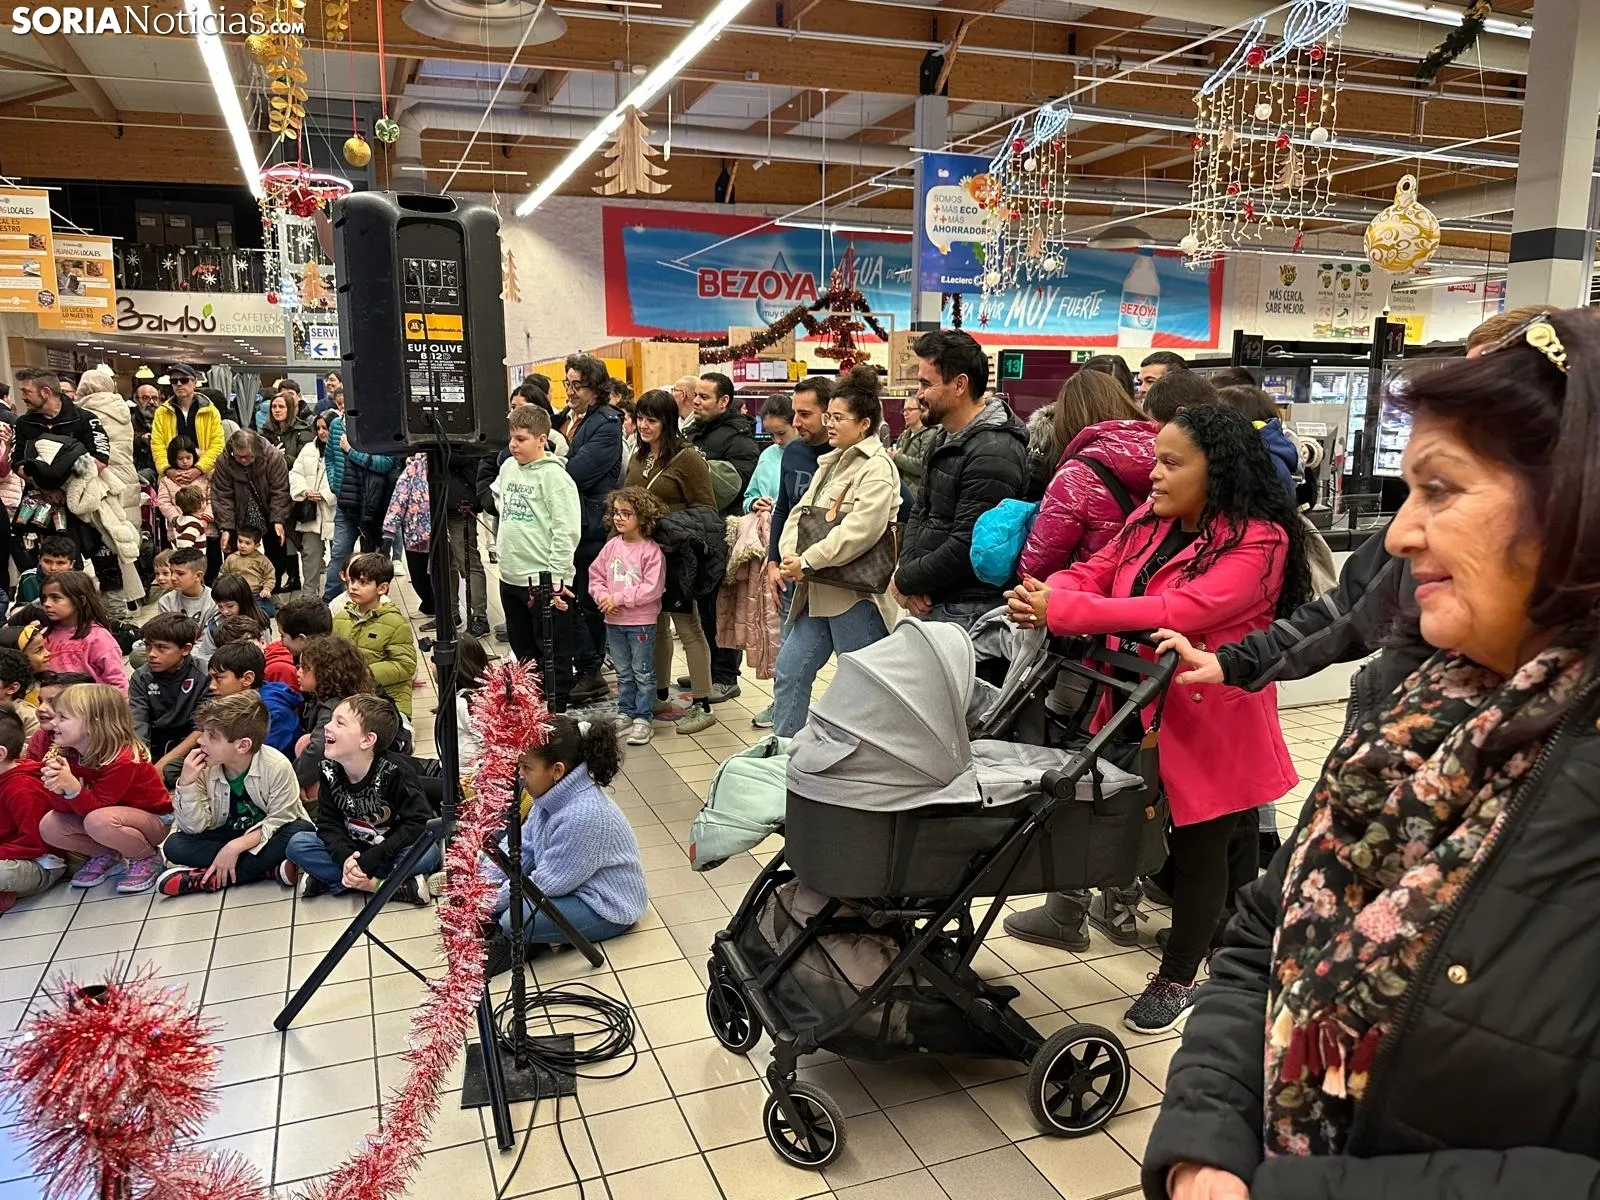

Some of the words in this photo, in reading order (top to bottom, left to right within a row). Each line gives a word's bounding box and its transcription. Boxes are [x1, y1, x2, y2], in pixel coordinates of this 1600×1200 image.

[933, 195, 963, 204] SOMOS
[7, 206, 34, 215] LOCALES
[960, 206, 978, 215] ECO
[698, 269, 818, 301] BEZOYA
[941, 276, 973, 285] E.Leclerc
[1269, 288, 1282, 300] MÁS
[1283, 290, 1304, 301] CERCA.
[1057, 289, 1105, 321] FUERTE
[1120, 302, 1156, 318] BEZOYA
[1265, 302, 1281, 314] SABE
[1283, 303, 1306, 315] MEJOR.
[311, 327, 338, 338] SERVI
[420, 352, 451, 361] B12D
[1006, 360, 1021, 373] 13
